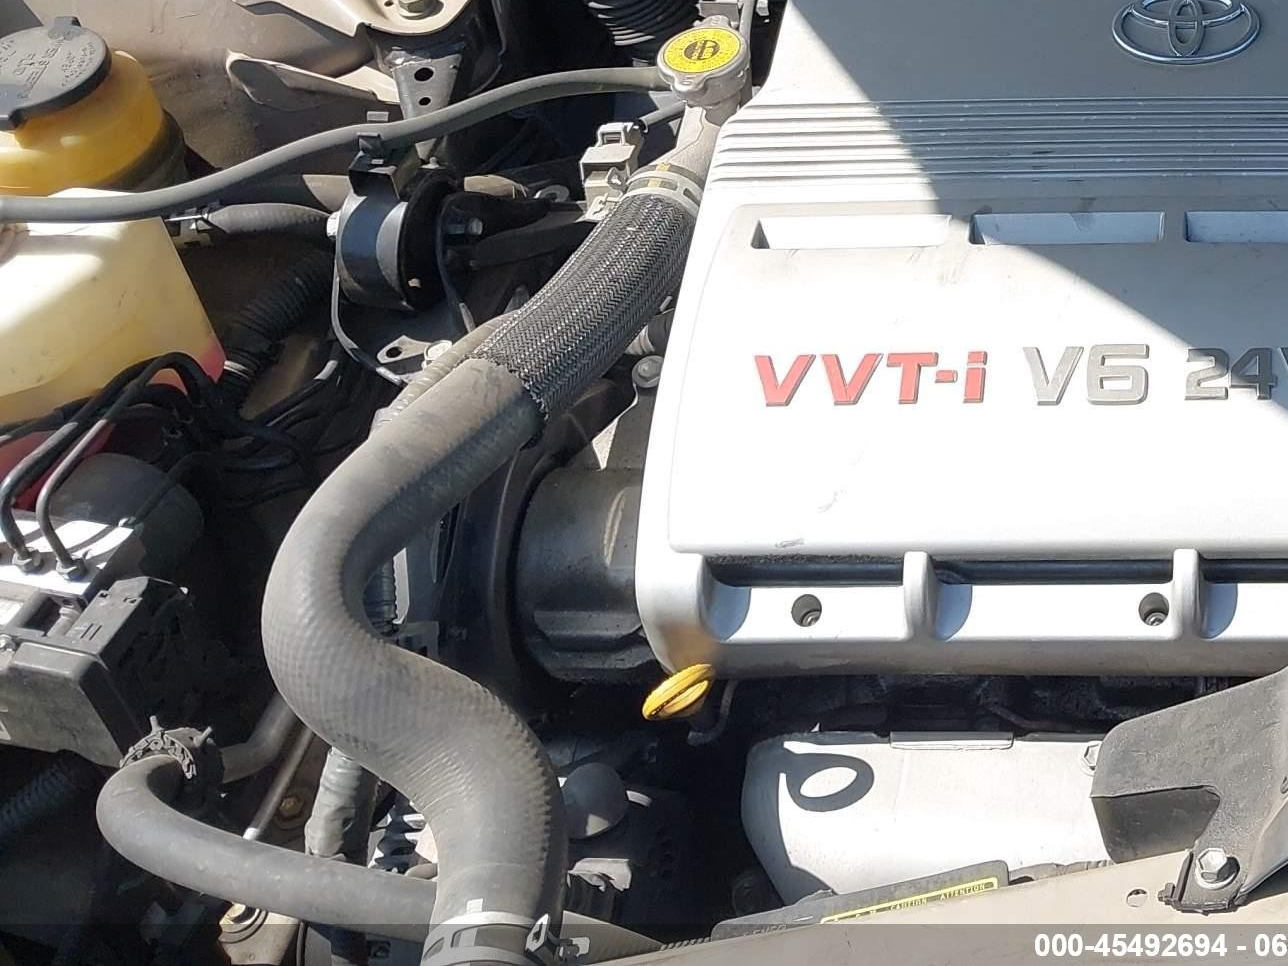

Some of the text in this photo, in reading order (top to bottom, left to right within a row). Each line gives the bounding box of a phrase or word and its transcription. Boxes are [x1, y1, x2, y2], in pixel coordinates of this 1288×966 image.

[753, 350, 988, 407] VVT-i
[1022, 343, 1150, 406] V6
[889, 882, 986, 912] CAUTION ATTENTION
